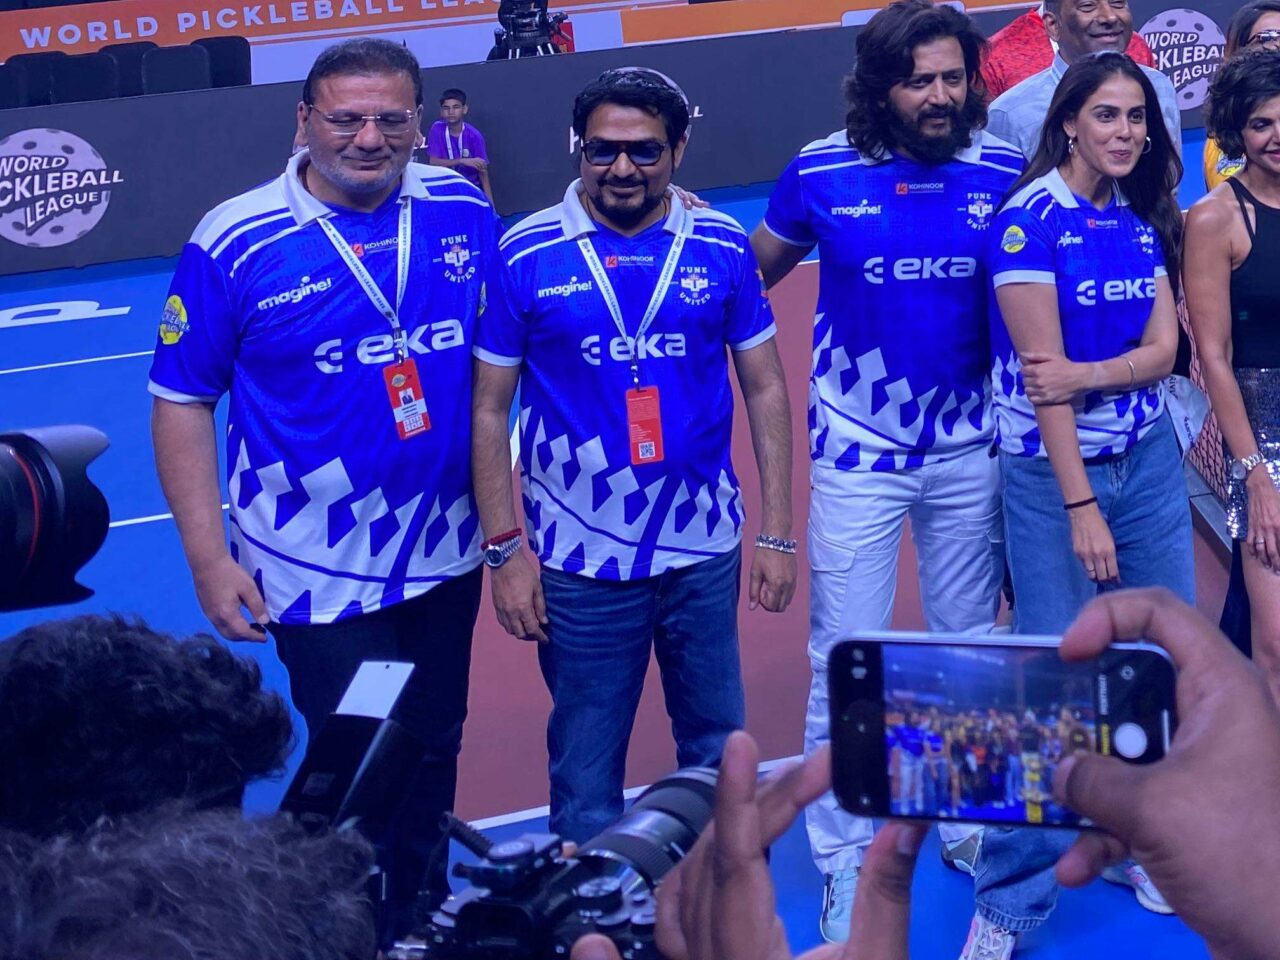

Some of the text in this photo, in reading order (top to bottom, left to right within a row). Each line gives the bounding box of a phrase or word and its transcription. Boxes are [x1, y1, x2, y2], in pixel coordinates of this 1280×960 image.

[20, 17, 159, 48] WORLD
[1145, 32, 1198, 50] WORLD
[0, 156, 67, 177] WORLD
[967, 192, 992, 200] PUNE
[25, 190, 99, 229] LEAGUE
[364, 237, 399, 250] KOHINO
[441, 234, 468, 246] PUNE
[444, 266, 476, 284] UNITED
[680, 266, 708, 274] PUNE
[894, 256, 977, 281] eka
[679, 291, 711, 307] UNITED
[356, 318, 465, 366] eka
[609, 333, 687, 362] eka
